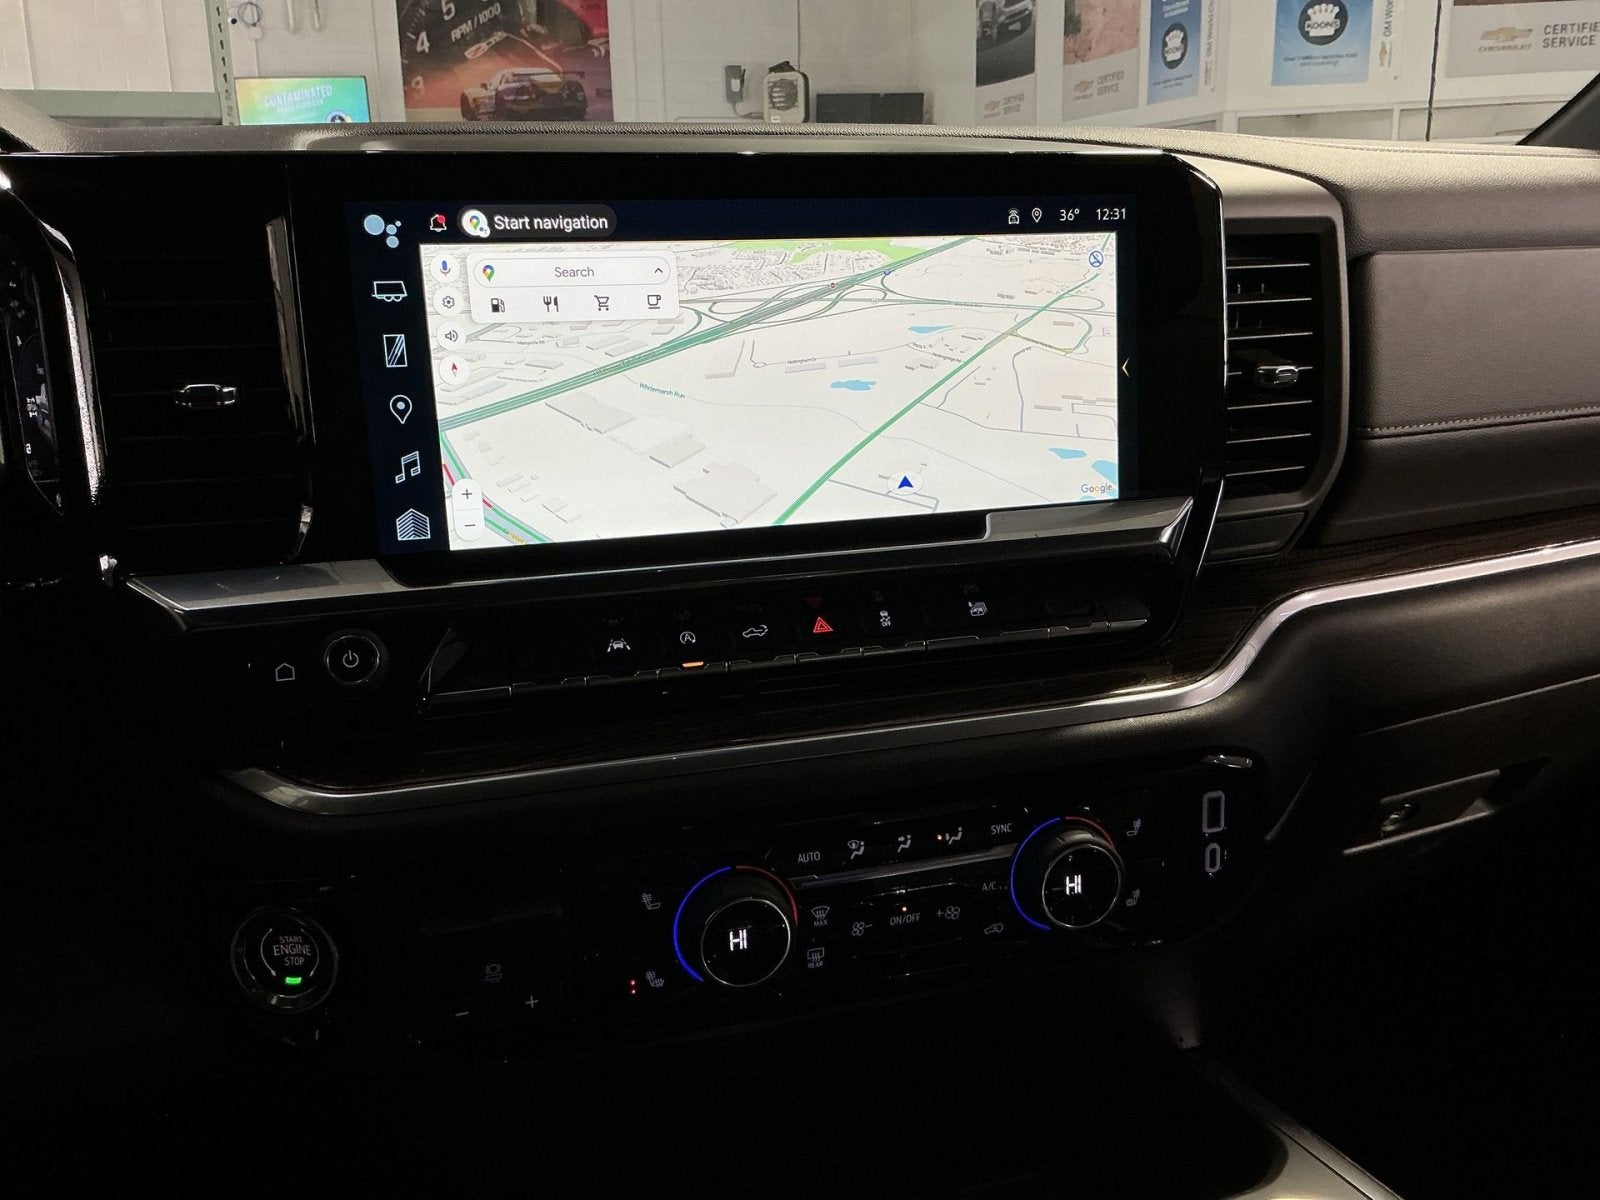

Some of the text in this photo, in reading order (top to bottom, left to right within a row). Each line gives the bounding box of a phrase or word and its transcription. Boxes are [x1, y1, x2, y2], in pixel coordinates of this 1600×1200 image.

[1305, 20, 1340, 31] KOONS
[416, 31, 430, 53] 4
[1541, 34, 1597, 49] SERVICE
[1095, 207, 1127, 220] 12:31
[493, 214, 609, 233] Start navigation
[554, 265, 595, 278] Search
[1081, 482, 1112, 494] Google
[990, 823, 1012, 835] SYNC
[797, 851, 821, 864] AUTO
[982, 881, 997, 892] A/C
[1065, 874, 1082, 896] HI
[813, 919, 828, 927] MAX
[889, 912, 921, 926] ON/OFF
[729, 929, 748, 951] HI
[273, 943, 311, 956] ENGINE
[284, 956, 305, 966] STOP
[807, 960, 824, 969] REAR
